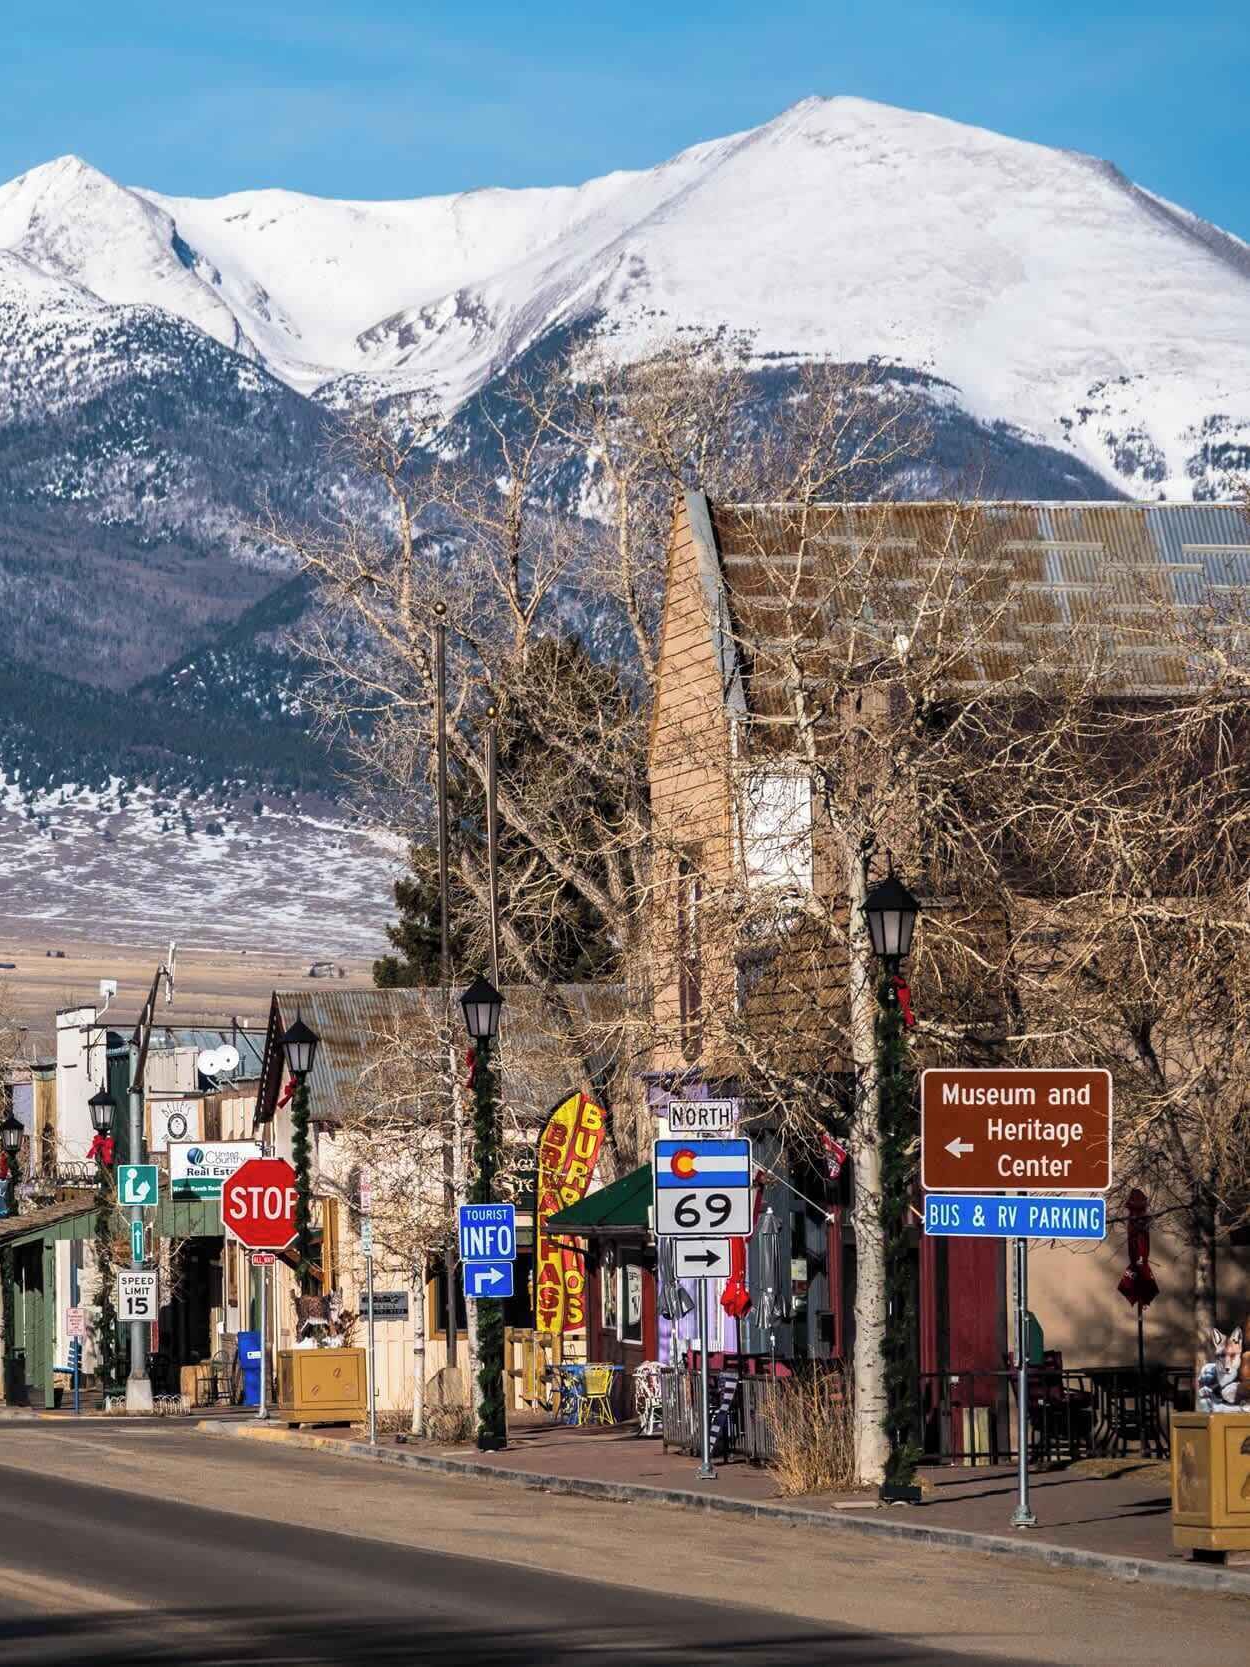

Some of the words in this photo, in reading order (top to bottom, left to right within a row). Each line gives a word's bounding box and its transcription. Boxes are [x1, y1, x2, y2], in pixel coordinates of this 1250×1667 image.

[941, 1083, 1036, 1106] Museum
[1048, 1083, 1091, 1106] and
[671, 1107, 730, 1127] NORTH
[987, 1118, 1083, 1148] Heritage
[186, 1167, 210, 1177] Real
[997, 1153, 1073, 1177] Center
[229, 1186, 299, 1220] STOP
[562, 1102, 602, 1324] BURROS
[673, 1193, 733, 1228] 69
[466, 1209, 508, 1221] TOURIST
[929, 1203, 960, 1227] BUS
[972, 1204, 986, 1227] &
[998, 1205, 1018, 1228] RV
[1029, 1206, 1100, 1230] PARKING
[463, 1225, 512, 1256] INFO
[121, 1277, 154, 1285] SPEED
[125, 1287, 150, 1295] LIMIT
[126, 1297, 149, 1315] 15
